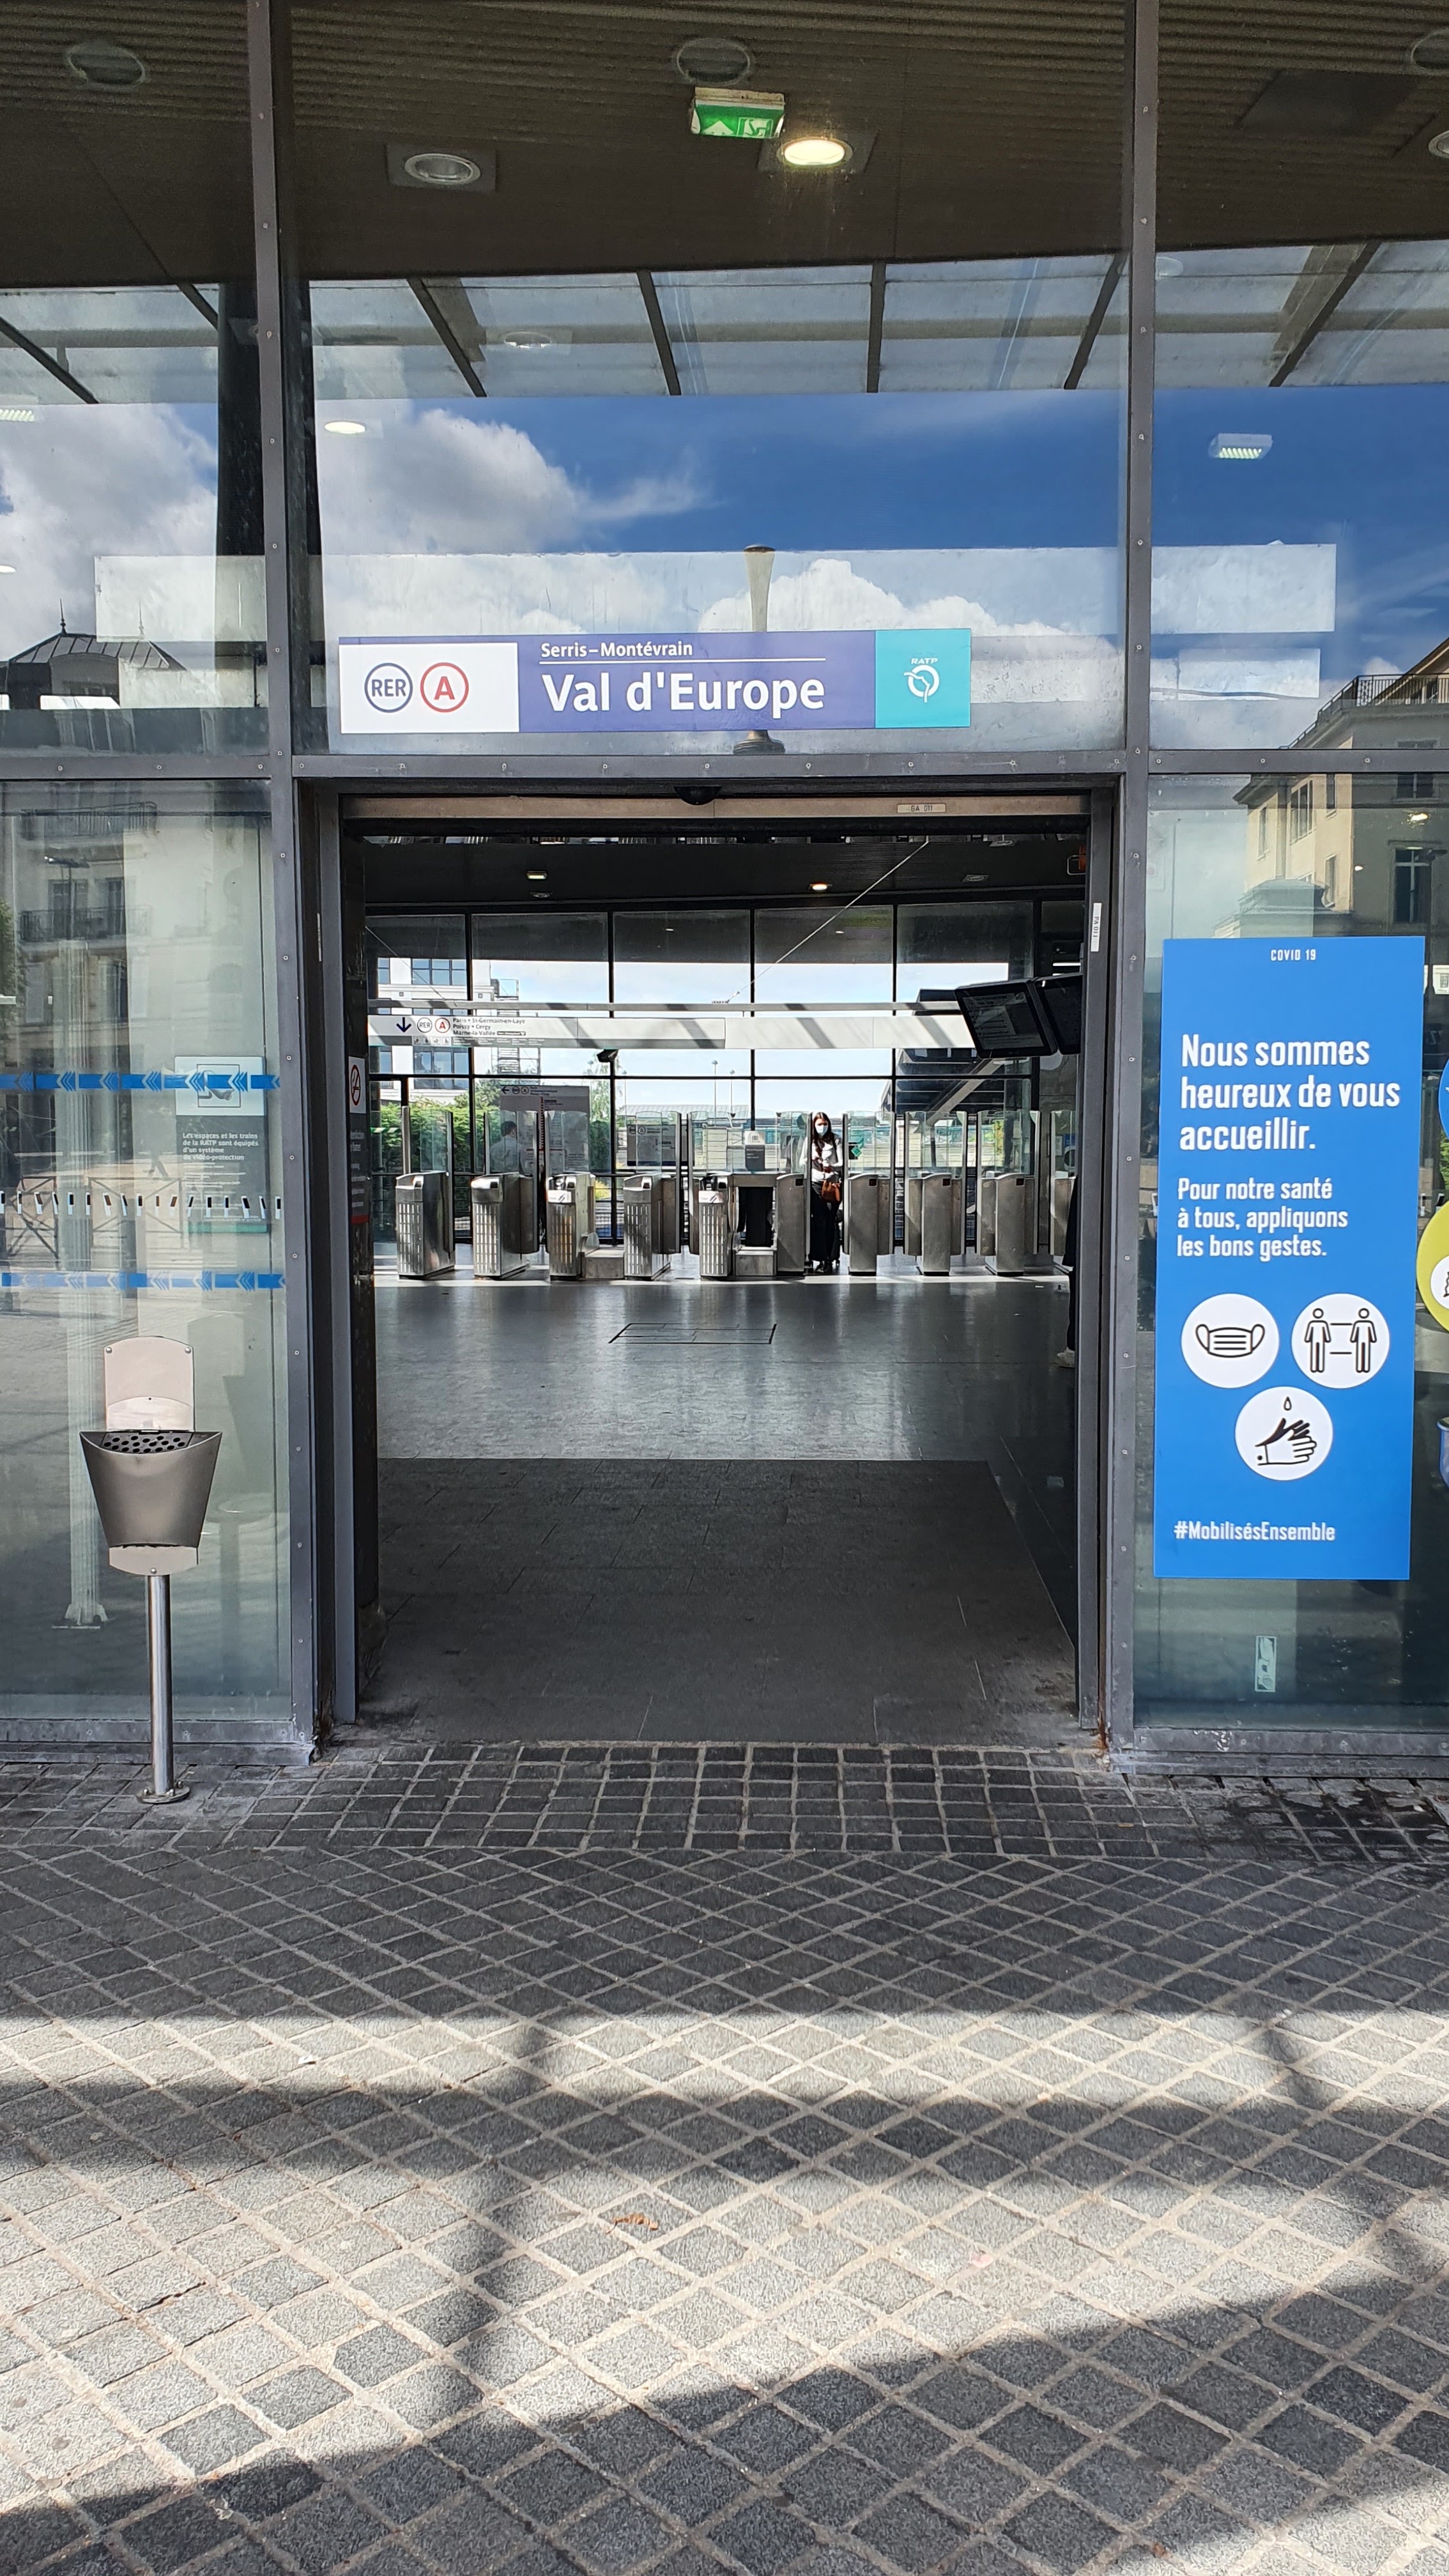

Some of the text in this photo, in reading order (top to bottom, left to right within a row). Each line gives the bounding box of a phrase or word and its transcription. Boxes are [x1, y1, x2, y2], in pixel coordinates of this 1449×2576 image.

[541, 641, 693, 658] Serris-Montévrain
[371, 675, 456, 700] RER A
[541, 671, 825, 719] Val d'Europe
[1270, 949, 1317, 962] COVID 19
[1181, 1034, 1370, 1068] Nous sommes
[1181, 1074, 1400, 1109] heureux de vous
[1179, 1117, 1316, 1151] accueillir.
[1178, 1177, 1333, 1200] Pour notre santé
[1177, 1206, 1348, 1233] à tous, appliquons
[1177, 1234, 1328, 1262] les bons gestes.
[1173, 1520, 1336, 1541] #MobilisésEnsemble
